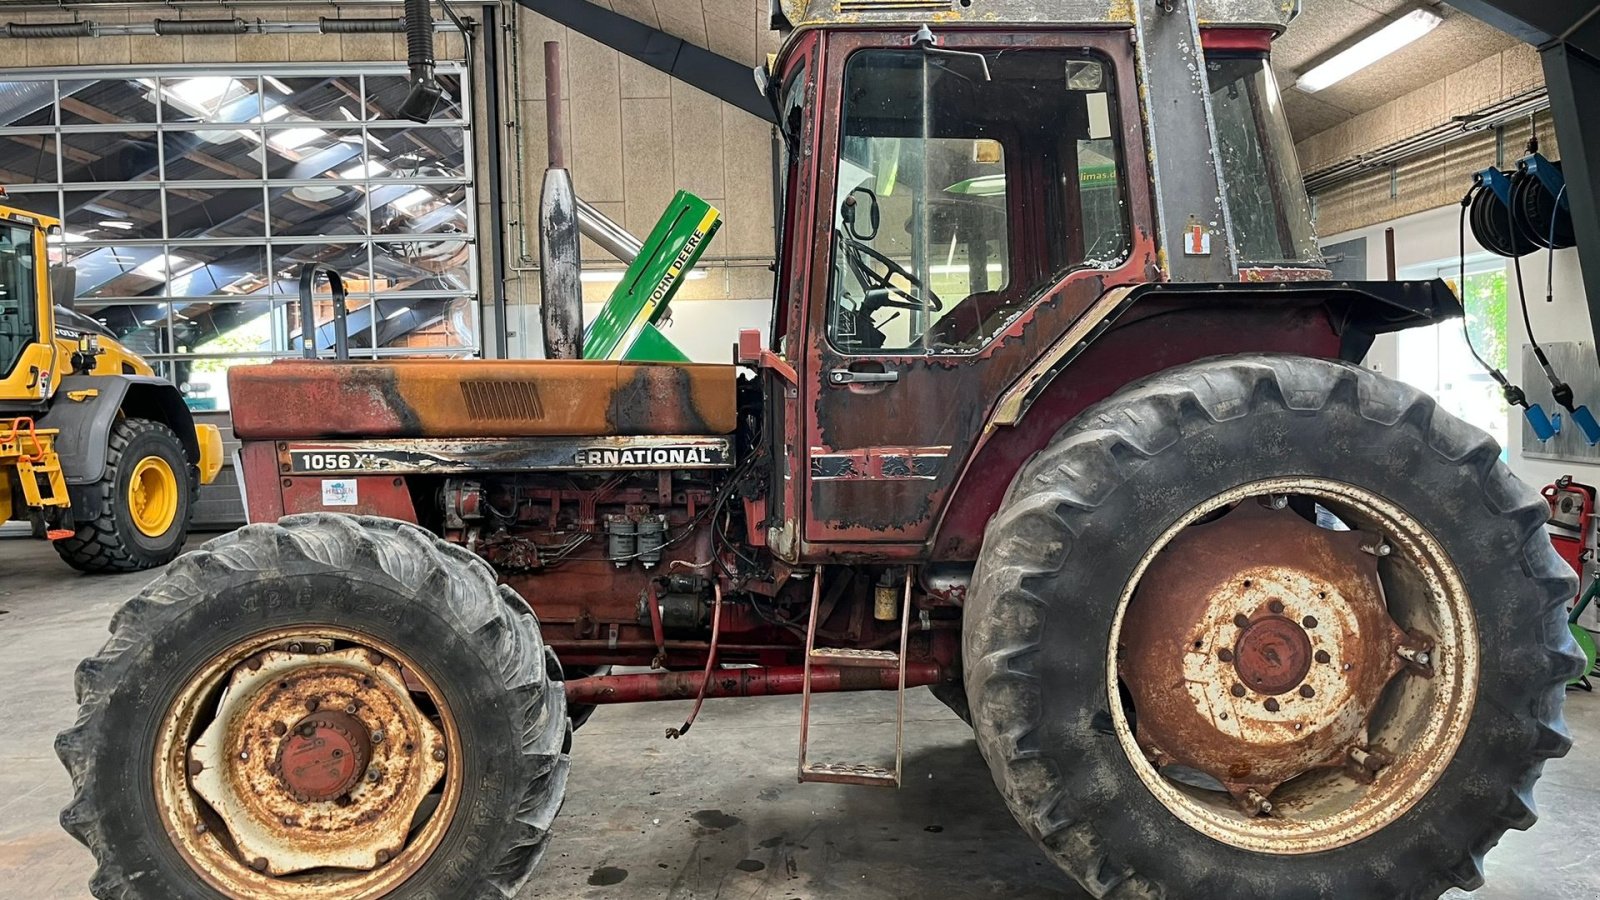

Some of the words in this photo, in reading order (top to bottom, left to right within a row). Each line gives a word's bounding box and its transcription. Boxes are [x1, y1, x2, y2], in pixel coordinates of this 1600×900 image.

[649, 272, 675, 308] JOHN
[672, 229, 705, 271] DEERE
[302, 454, 351, 470] 1056
